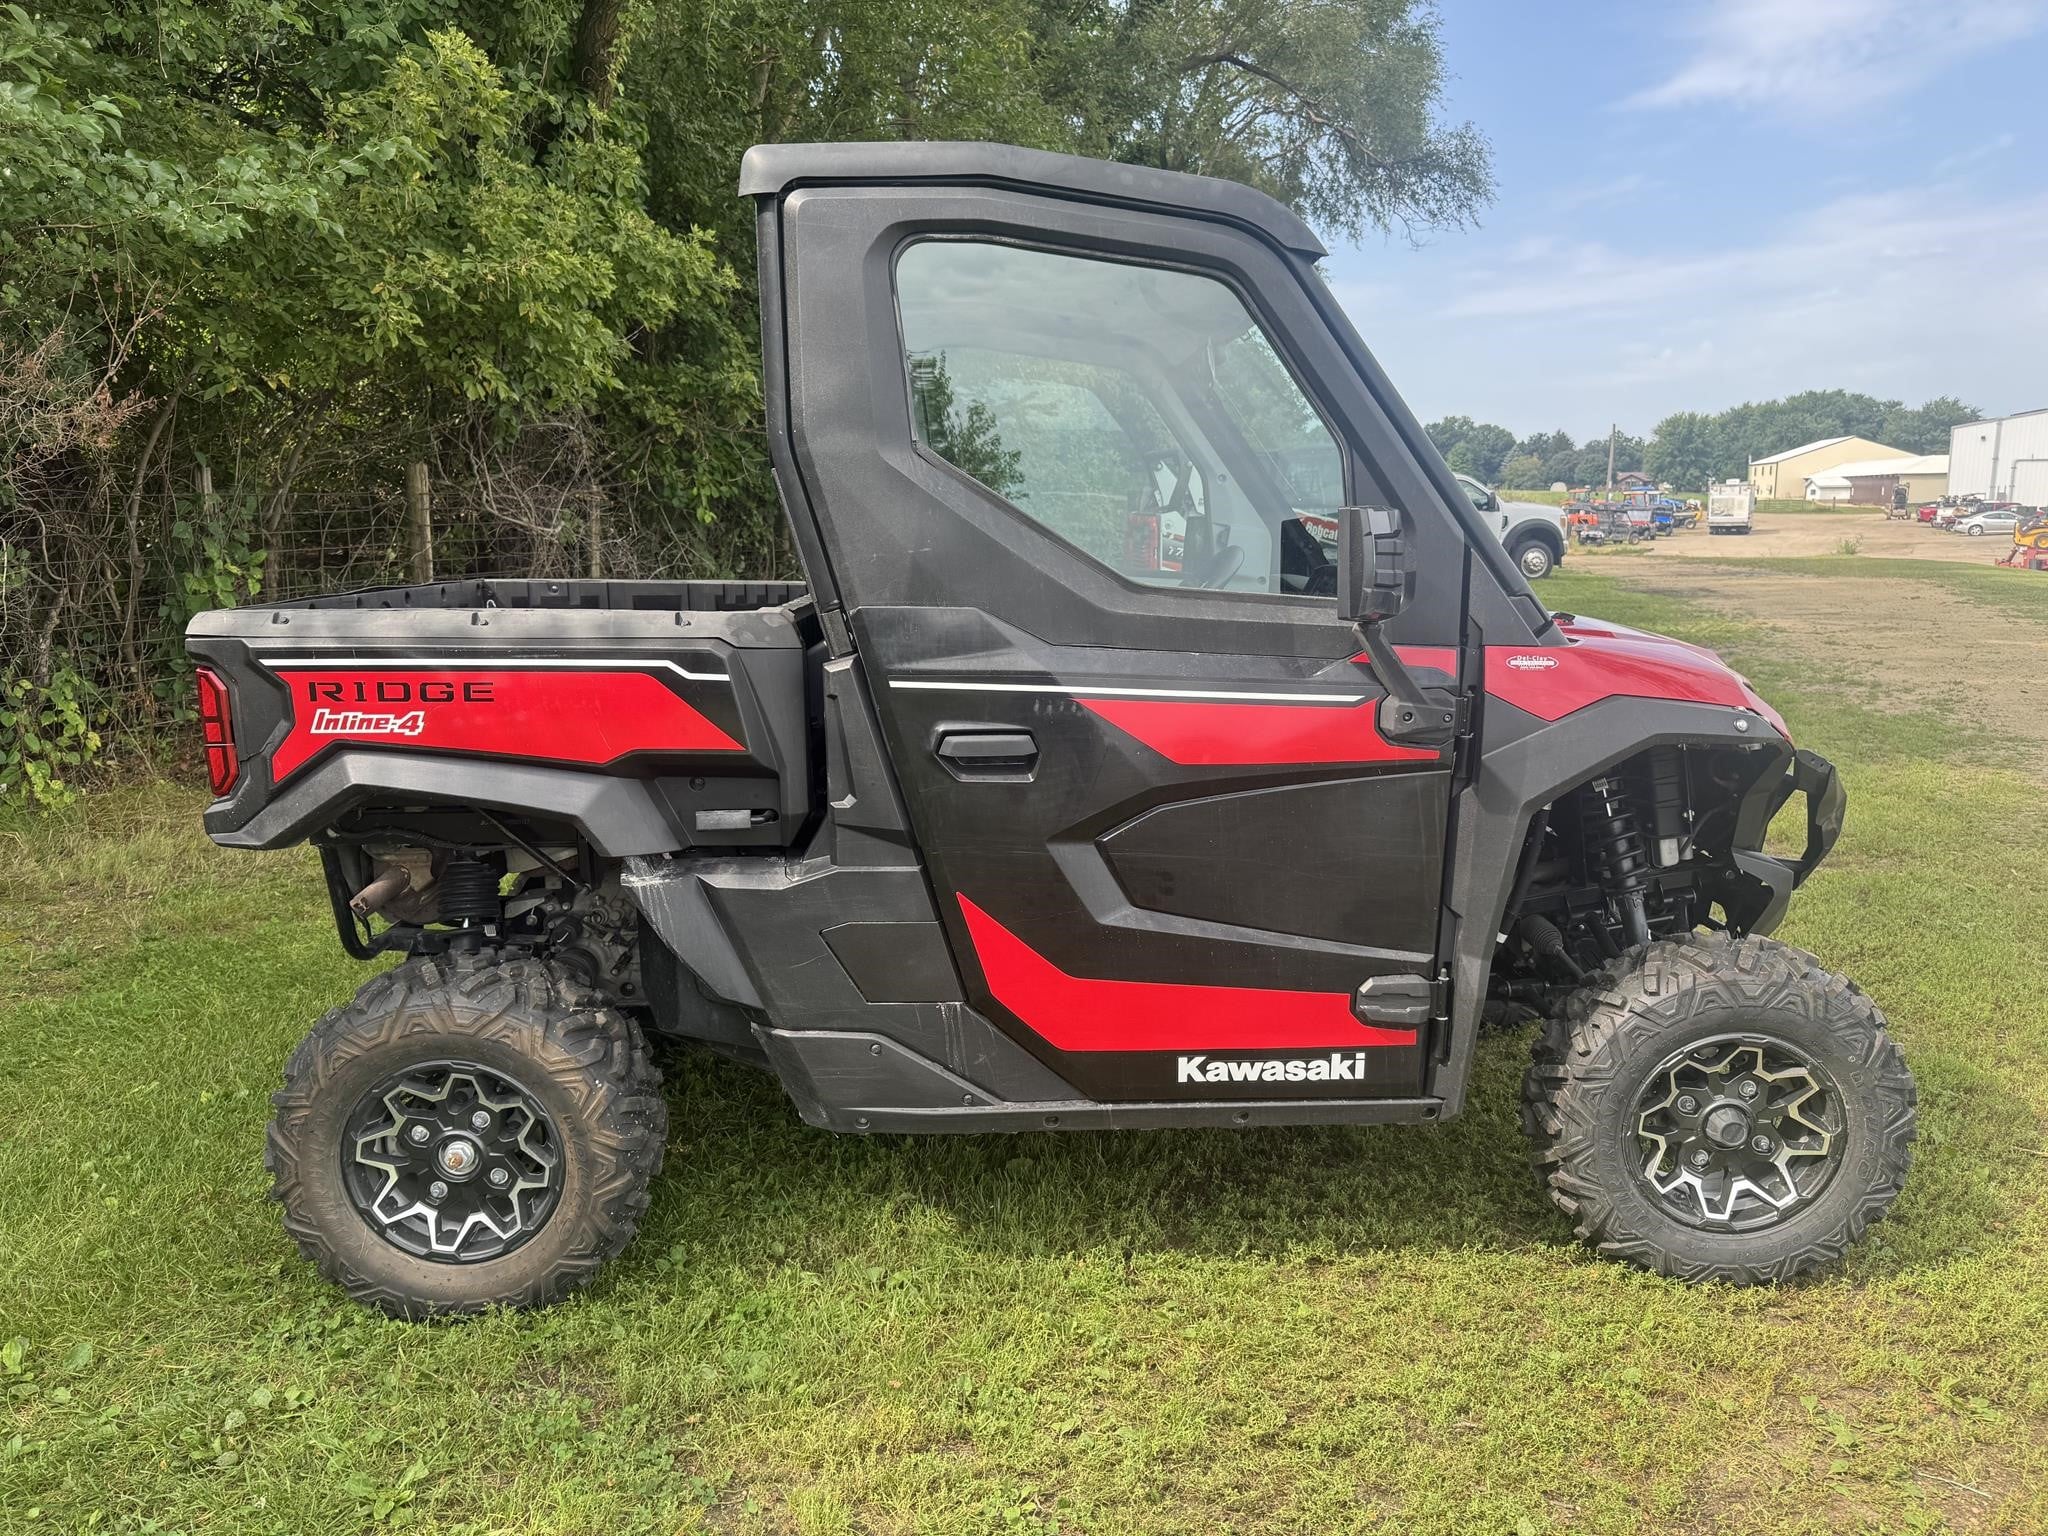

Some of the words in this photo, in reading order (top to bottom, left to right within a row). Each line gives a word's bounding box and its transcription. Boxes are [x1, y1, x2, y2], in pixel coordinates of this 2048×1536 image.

[308, 681, 495, 702] RIDGE
[310, 708, 425, 736] Inline-4
[1177, 1052, 1366, 1083] Kawasaki
